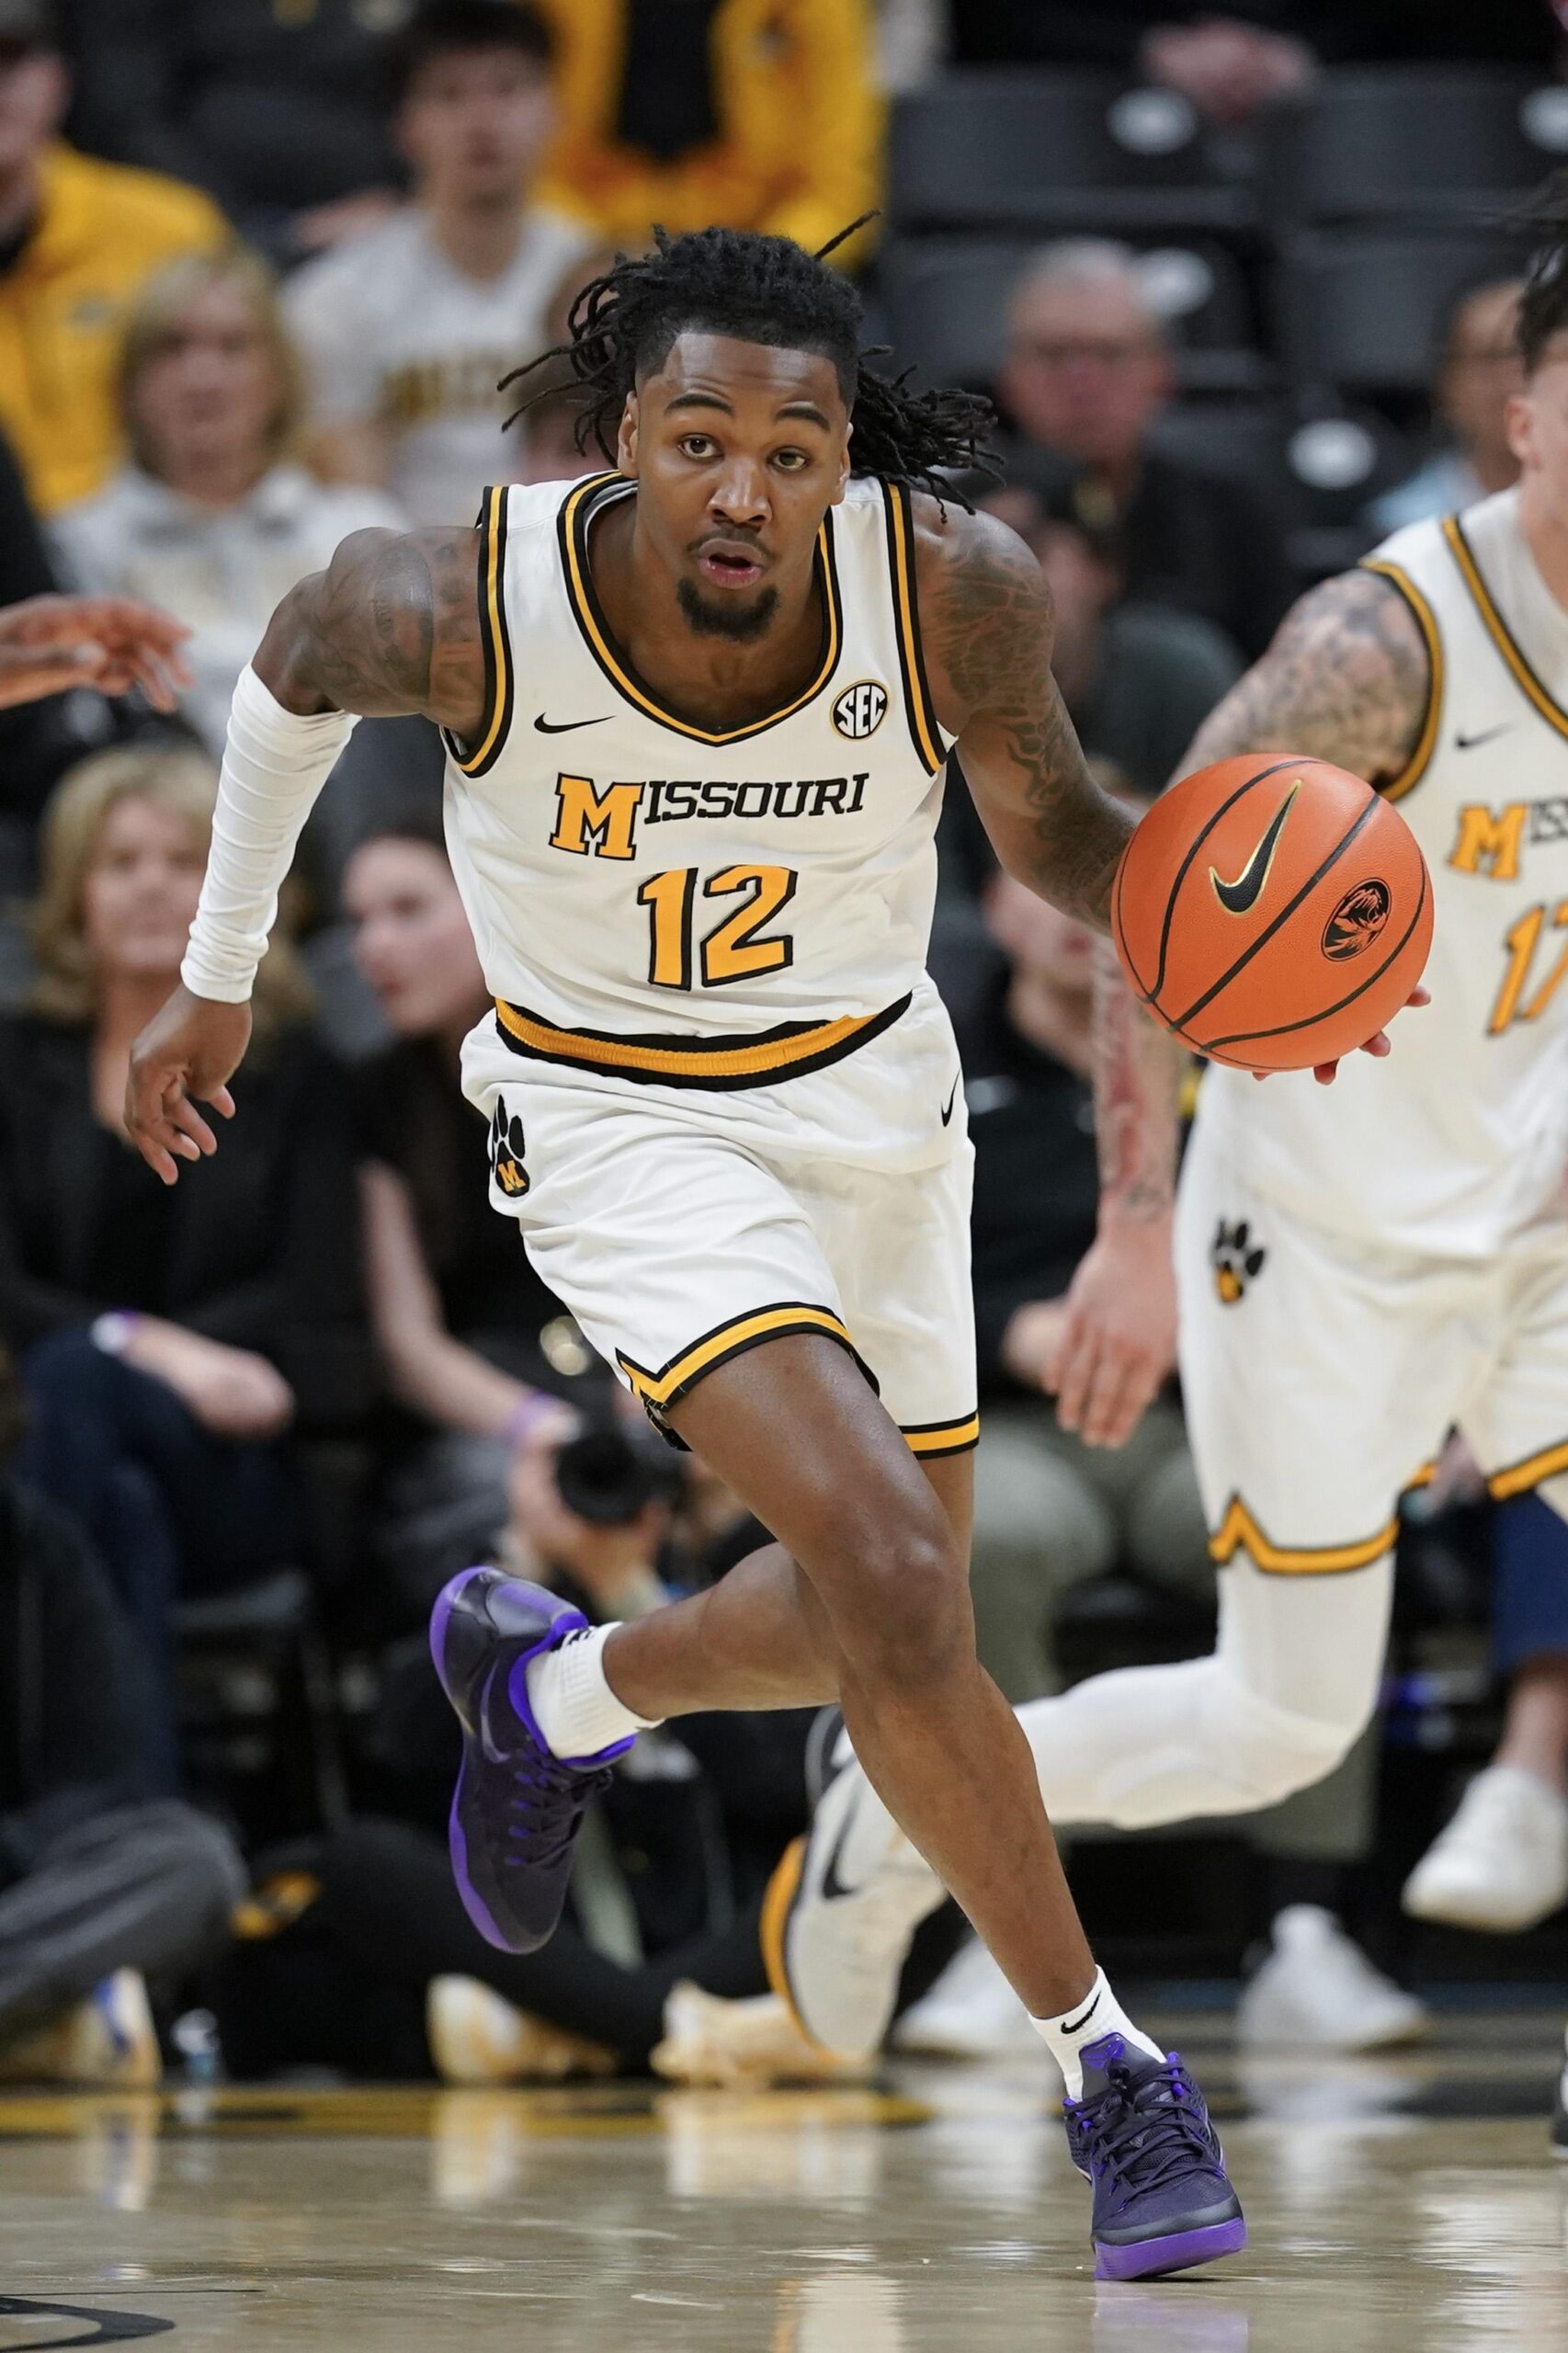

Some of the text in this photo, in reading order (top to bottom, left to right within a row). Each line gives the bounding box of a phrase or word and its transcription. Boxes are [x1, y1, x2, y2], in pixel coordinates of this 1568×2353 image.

[835, 684, 886, 737] SEC
[548, 772, 869, 860] MISSOURI
[637, 864, 798, 991] 12
[497, 1160, 526, 1192] M
